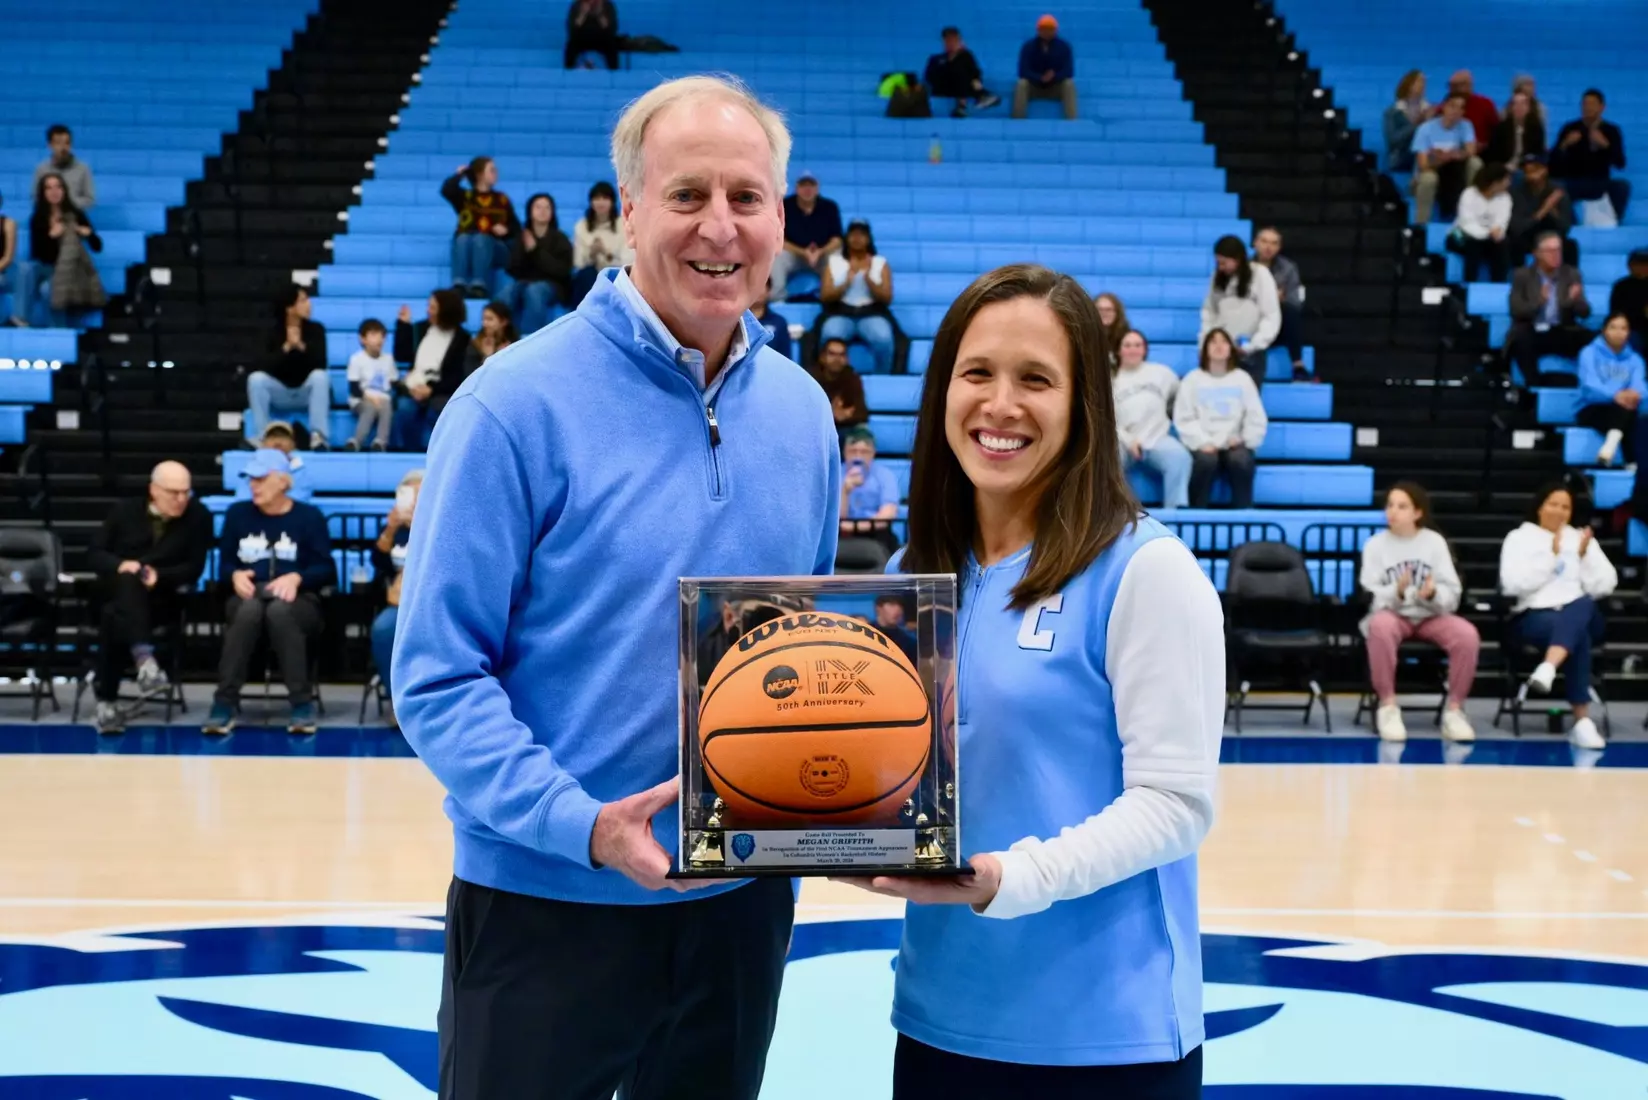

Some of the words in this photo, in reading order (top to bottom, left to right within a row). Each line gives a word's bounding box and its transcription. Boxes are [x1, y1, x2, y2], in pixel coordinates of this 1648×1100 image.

[736, 614, 890, 652] Wilson
[1016, 593, 1065, 652] C
[766, 679, 801, 693] NCAA
[815, 659, 876, 696] IX
[817, 673, 857, 681] TITLE
[777, 701, 799, 711] 50th
[803, 698, 867, 707] Anniversary
